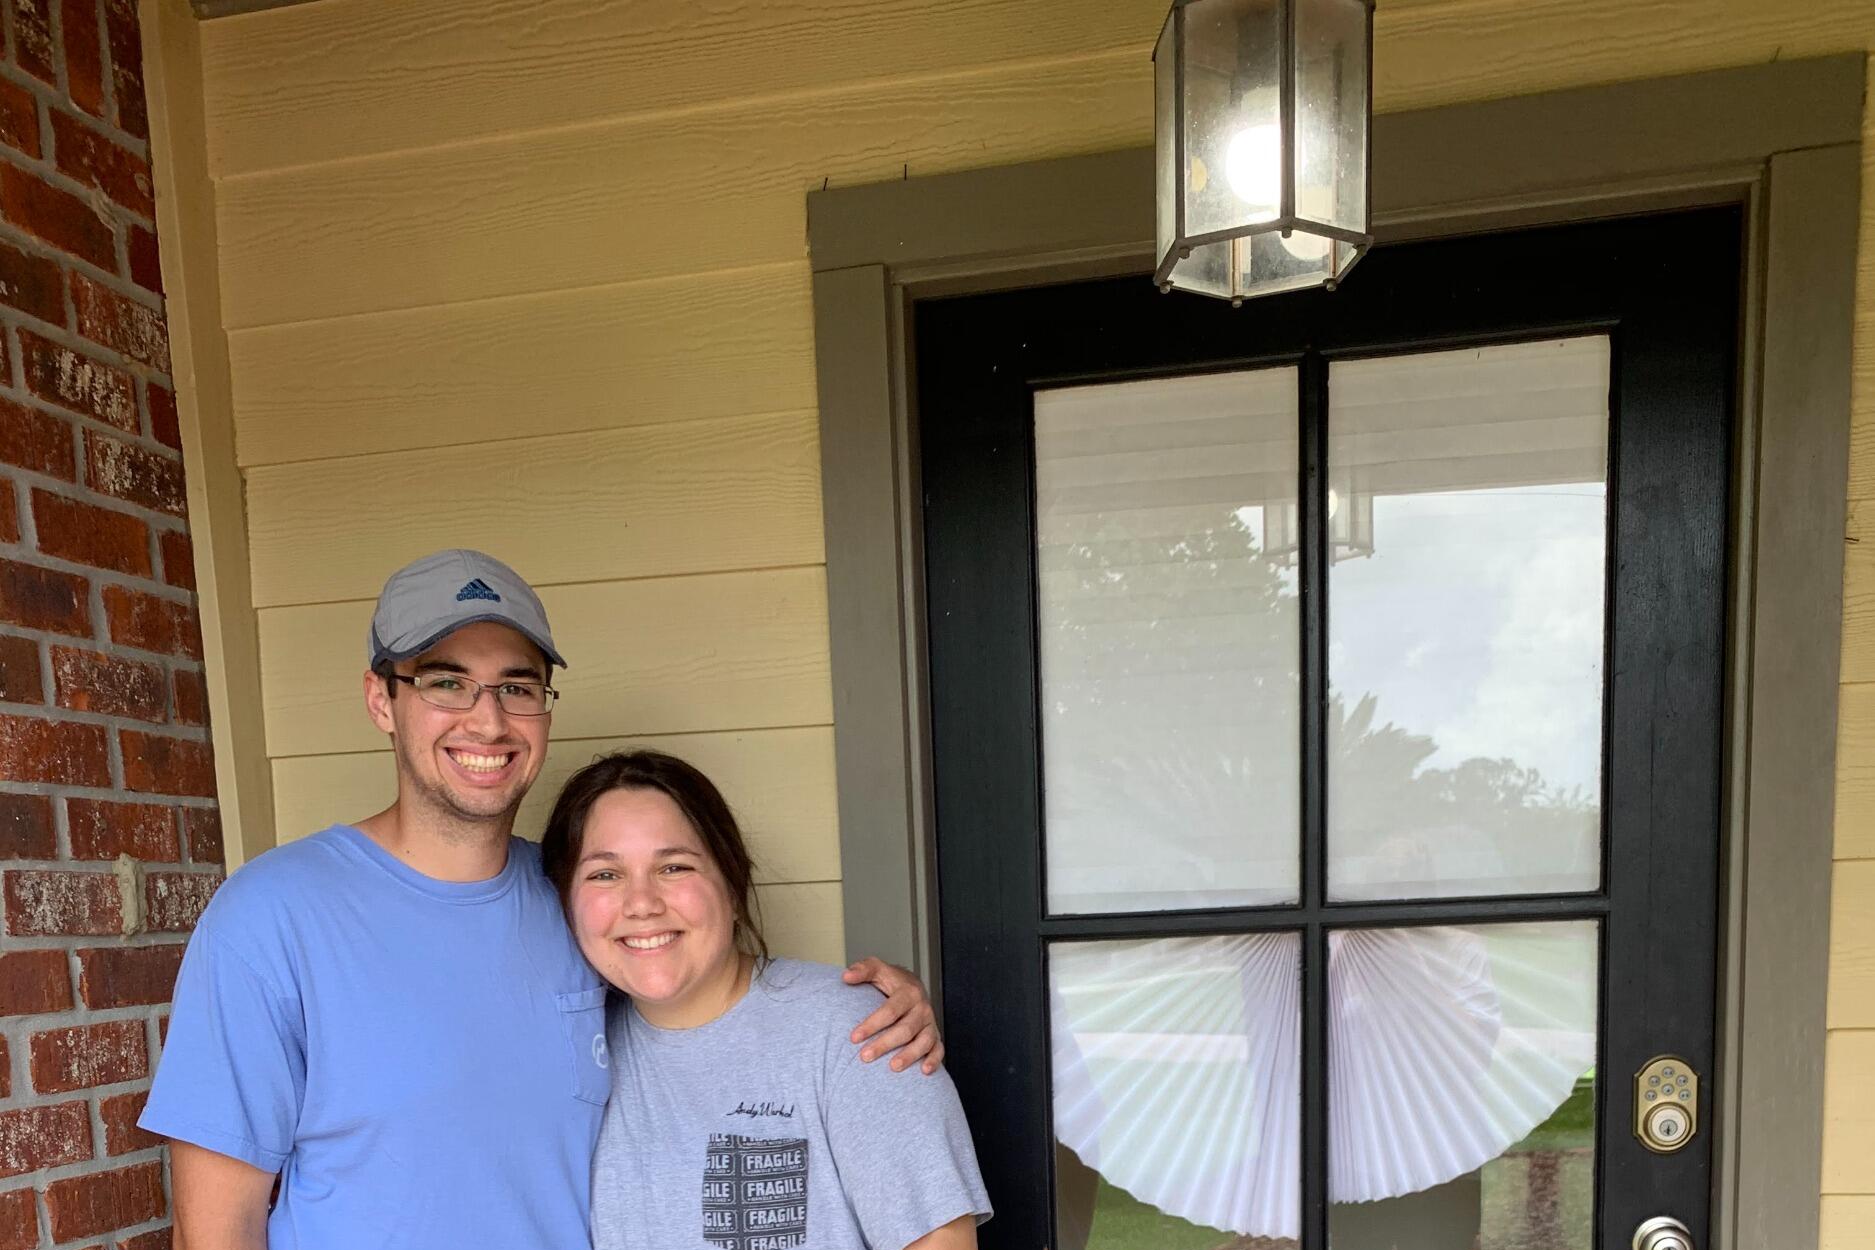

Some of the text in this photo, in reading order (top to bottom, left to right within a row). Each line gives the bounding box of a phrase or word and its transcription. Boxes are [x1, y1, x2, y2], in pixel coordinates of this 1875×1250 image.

[746, 1150, 801, 1170] FRAGILE
[747, 1178, 804, 1197] FRAGILE
[749, 1206, 805, 1225] FRAGILE
